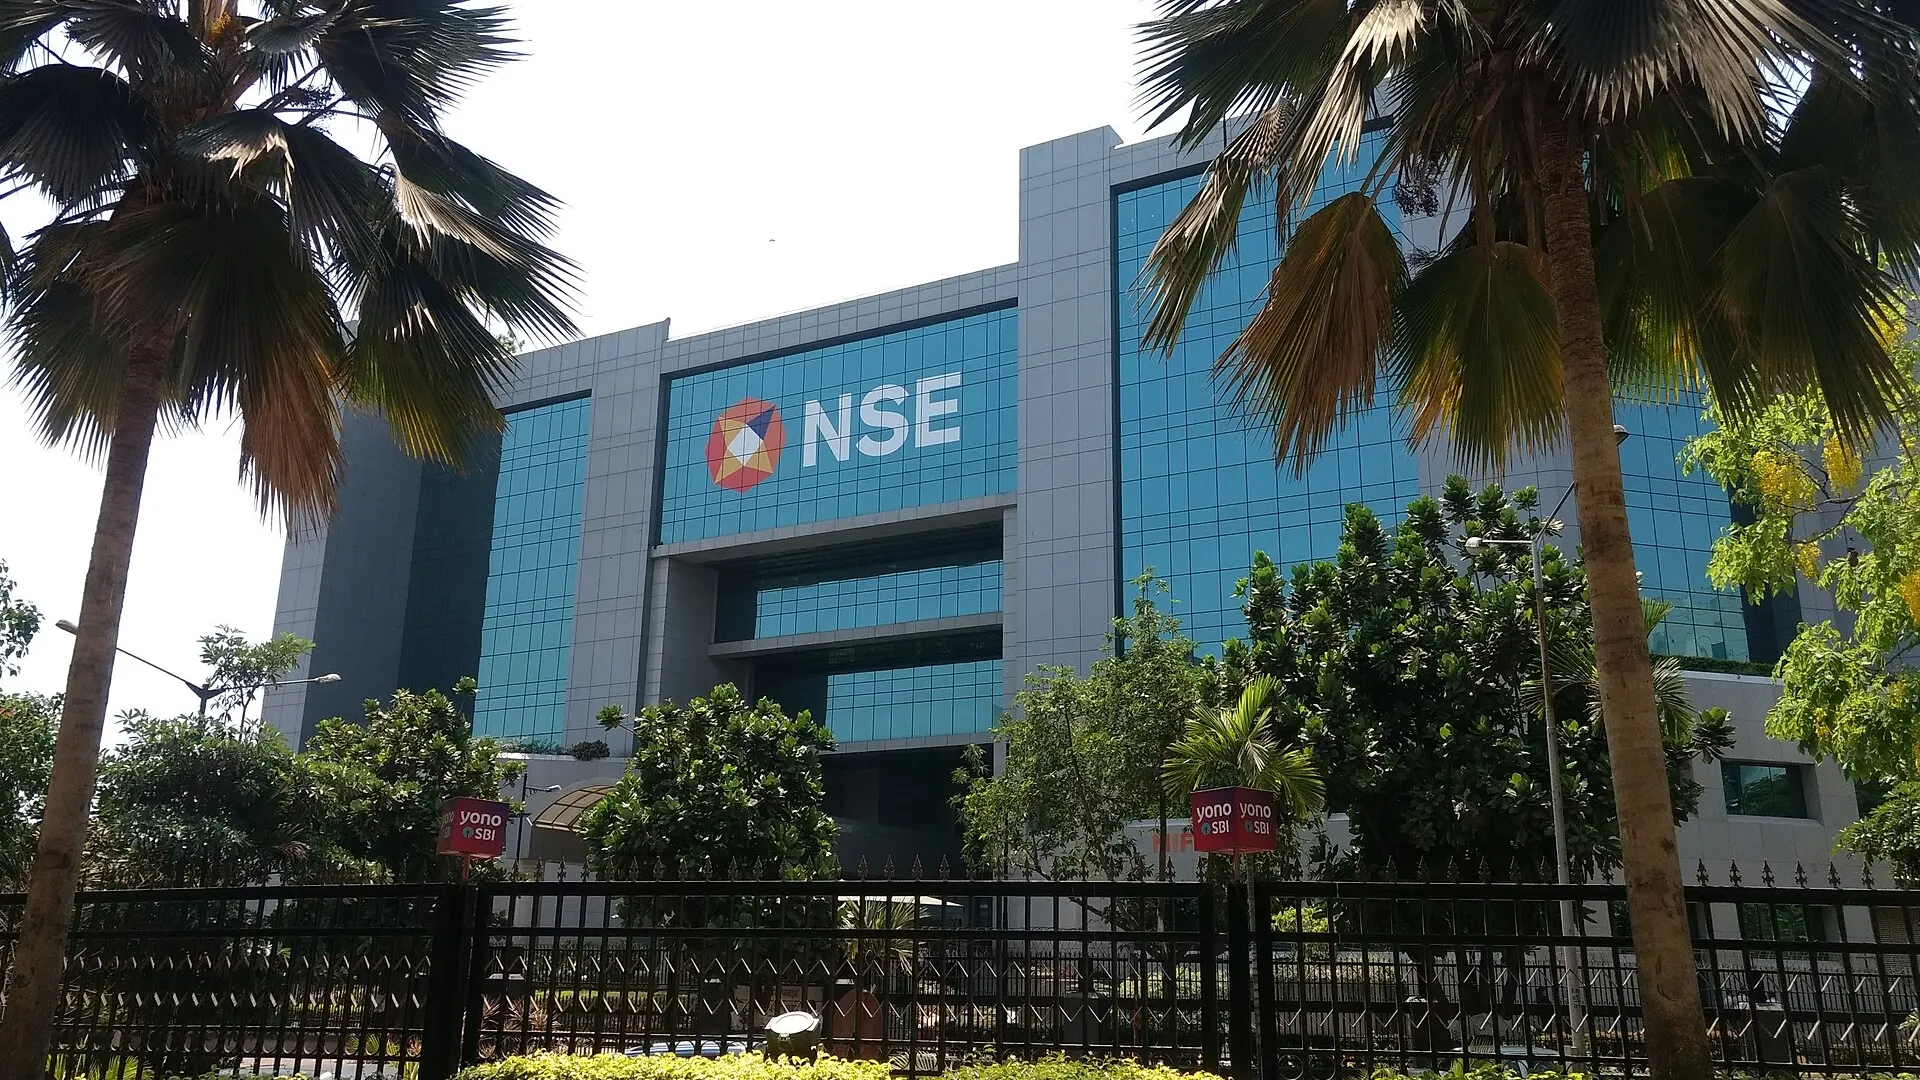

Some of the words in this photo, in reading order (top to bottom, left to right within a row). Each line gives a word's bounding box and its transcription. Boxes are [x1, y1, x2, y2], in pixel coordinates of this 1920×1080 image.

[803, 372, 961, 467] NSE
[1197, 803, 1232, 823] yono
[1239, 803, 1272, 818] yono
[460, 811, 502, 826] yono
[474, 828, 496, 841] SBI
[1211, 820, 1230, 834] SBI
[1253, 821, 1270, 835] SBI
[1152, 832, 1194, 853] NIF
